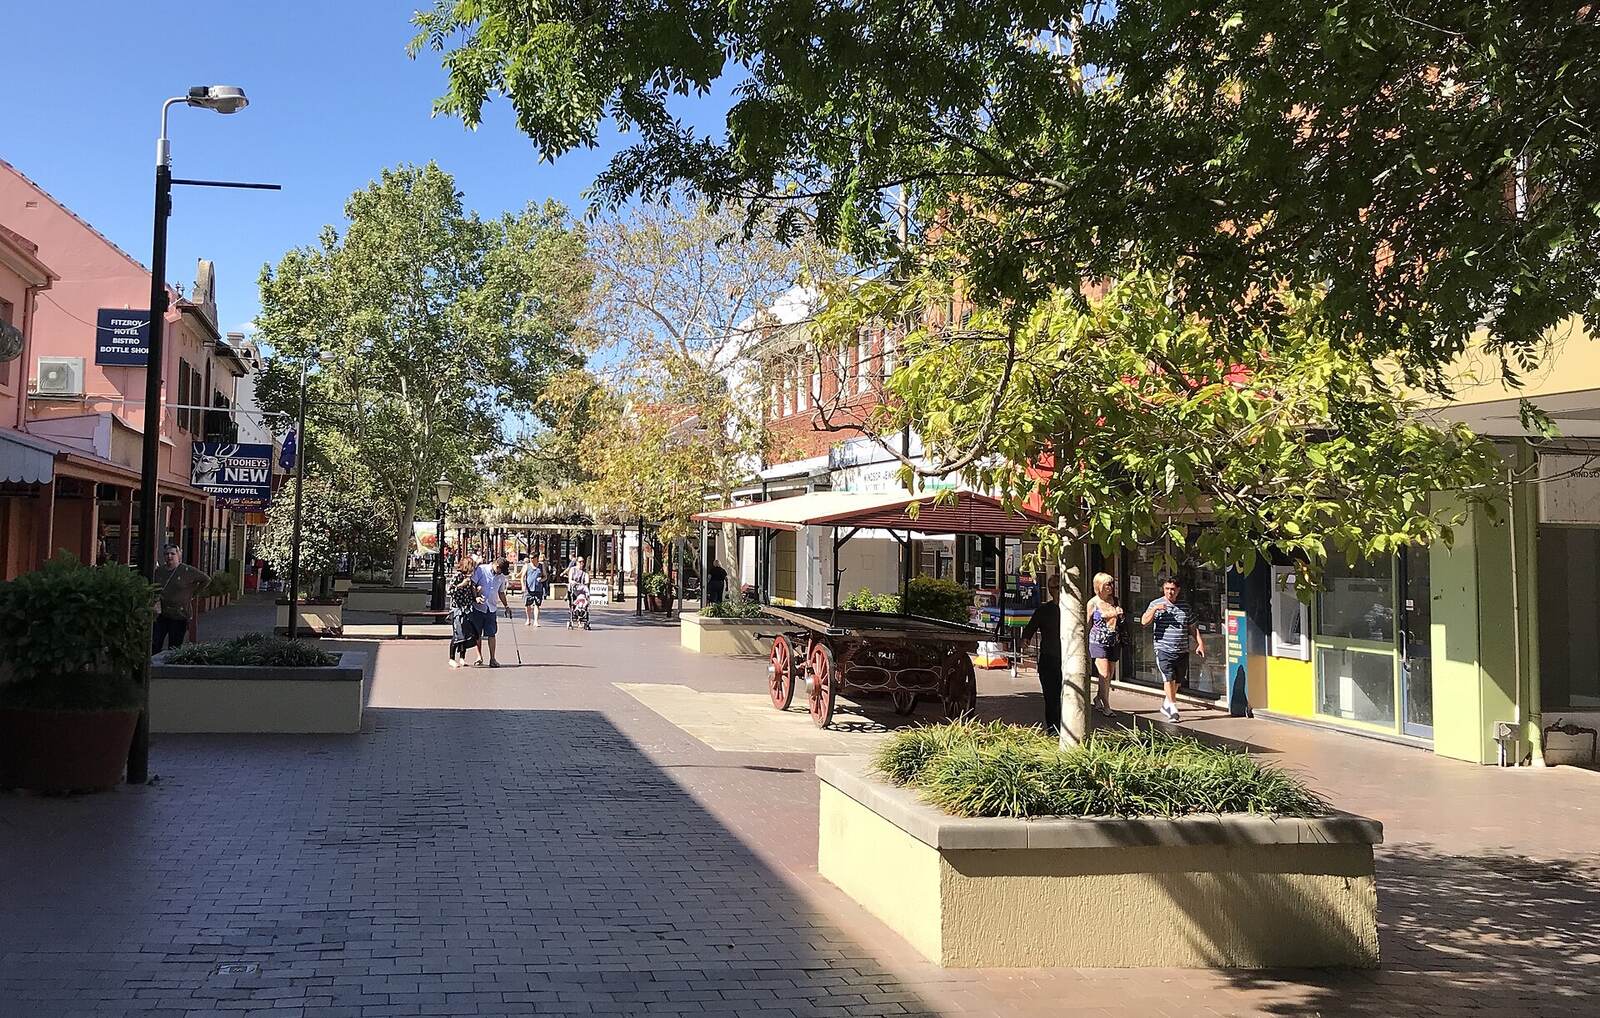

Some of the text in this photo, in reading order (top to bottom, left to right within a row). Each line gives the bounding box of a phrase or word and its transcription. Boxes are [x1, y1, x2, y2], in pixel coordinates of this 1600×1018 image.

[228, 458, 267, 467] TOOHEYS
[223, 467, 268, 483] NEW
[202, 486, 259, 495] FITZROY HOTEL
